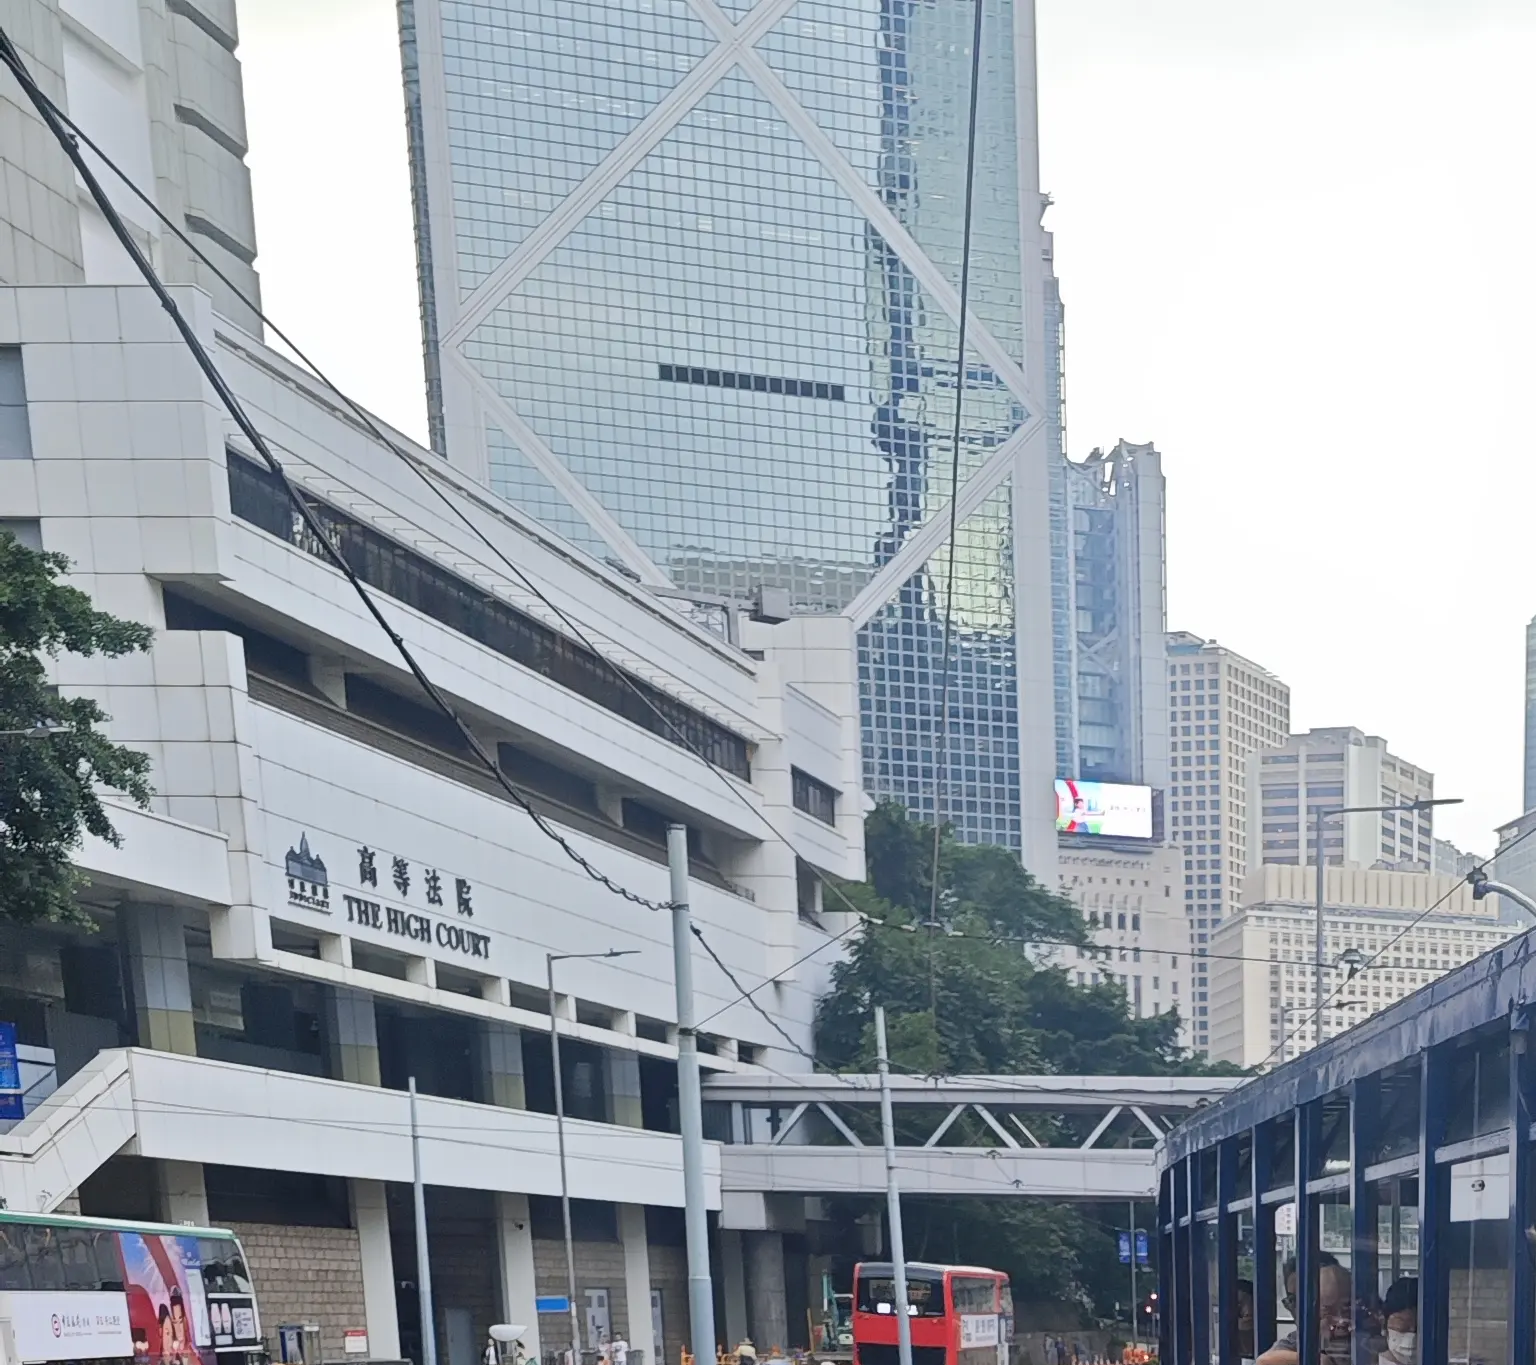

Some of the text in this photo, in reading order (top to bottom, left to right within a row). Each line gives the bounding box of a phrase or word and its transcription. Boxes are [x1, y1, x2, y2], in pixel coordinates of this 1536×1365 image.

[356, 845, 474, 918] 高等法院
[342, 894, 491, 960] THE HIGH COURT
